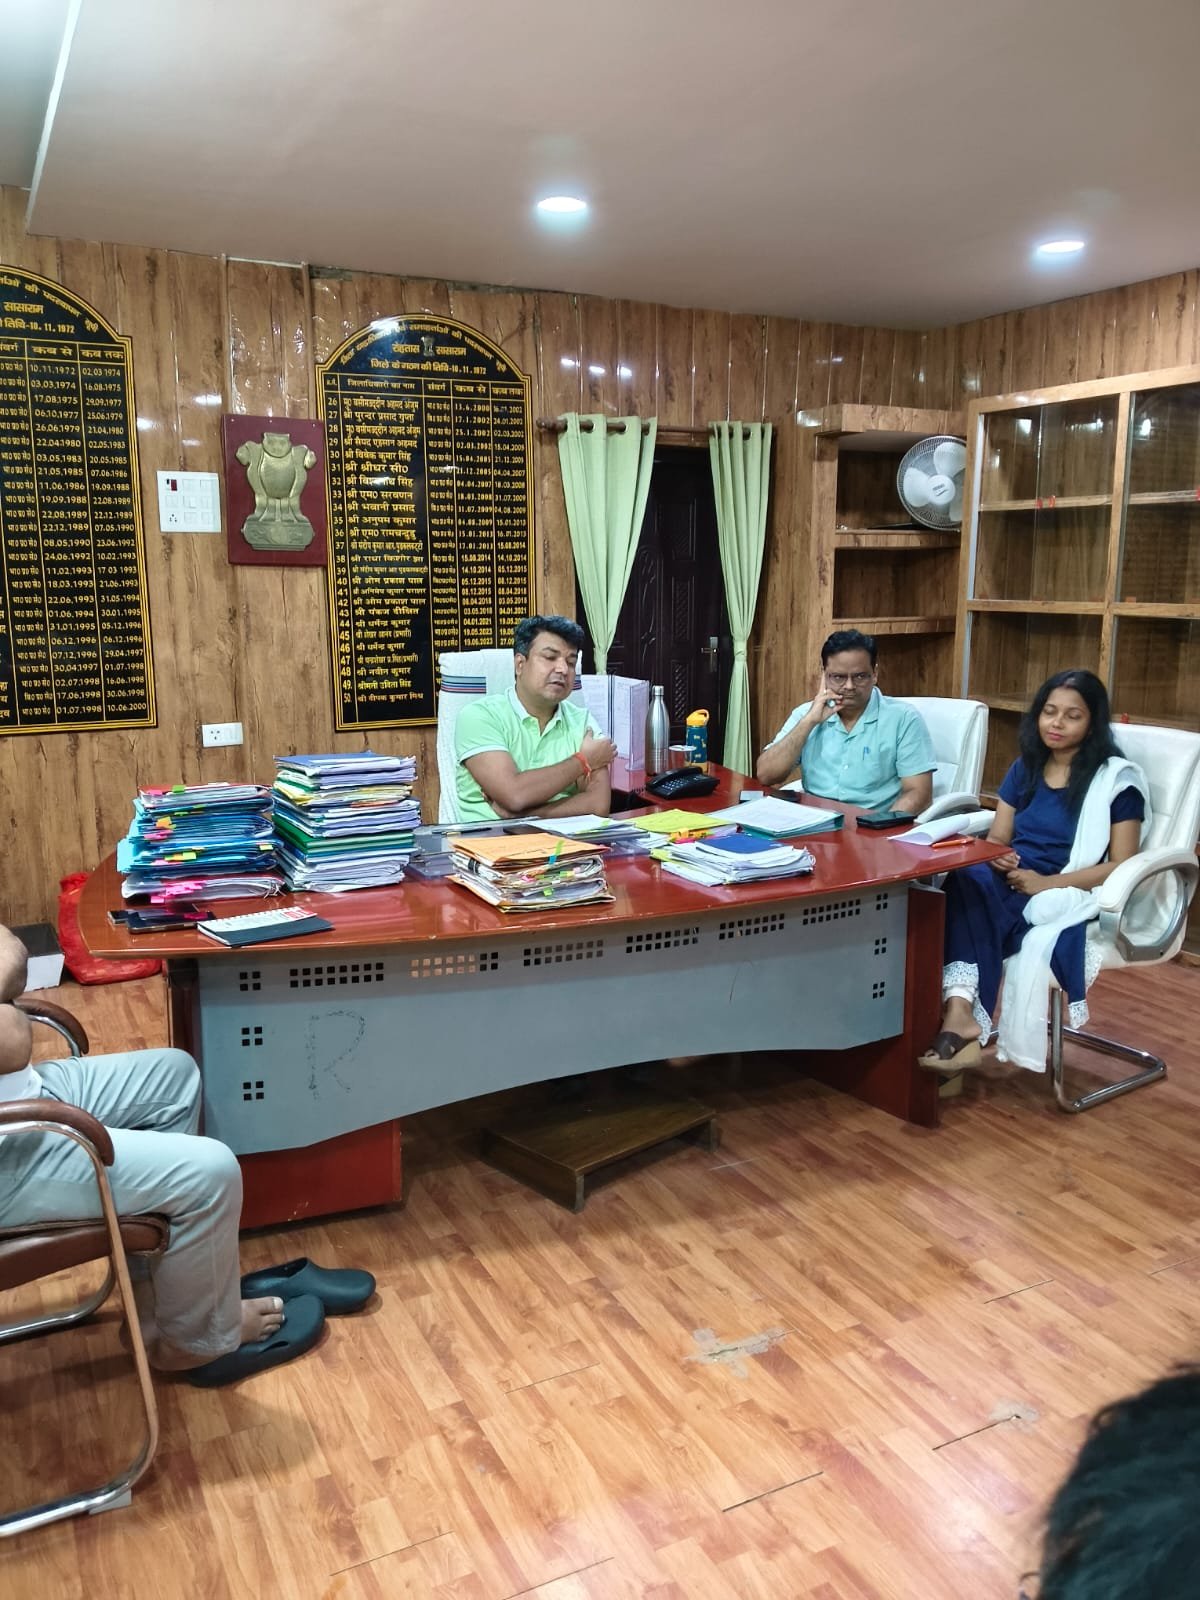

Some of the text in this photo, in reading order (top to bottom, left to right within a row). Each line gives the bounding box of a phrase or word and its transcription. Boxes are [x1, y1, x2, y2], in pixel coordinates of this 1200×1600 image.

[4, 301, 44, 314] सासाराम
[32, 346, 124, 359] कब से कब तक
[435, 346, 467, 356] सासाराम
[30, 364, 76, 375] 10.11.1972
[31, 380, 76, 389] 03.03.1974
[328, 397, 338, 406] 26
[35, 409, 79, 419] 06.10.1977
[328, 411, 338, 419] 27
[378, 412, 397, 420] प्रसाद
[36, 424, 80, 433] 26.06.1979
[329, 424, 338, 433] 28
[329, 438, 338, 446] 29
[37, 455, 82, 463] 03.05.1983
[330, 448, 412, 462] 30 श्री विवेक कुमार सिंह
[331, 461, 387, 472] 31 श्री श्रीधर
[38, 467, 84, 476] 21.05.1985
[332, 477, 341, 486] 32
[346, 474, 357, 485] श्री
[398, 476, 414, 487] सिंह
[40, 482, 85, 490] 11.06.1986
[332, 490, 342, 498] 33
[346, 488, 358, 498] श्री
[42, 496, 87, 504] 19.09.1988
[333, 503, 343, 511] 34
[347, 501, 358, 511] श्री
[391, 504, 416, 513] प्रसाद
[42, 511, 88, 520] 22.08.1989
[333, 516, 344, 524] 35
[348, 514, 360, 524] श्री
[392, 517, 416, 526] कुमार
[43, 524, 89, 532] 22.12.1989
[335, 526, 360, 537] 36 श्री
[43, 539, 91, 548] 08.05.1990
[335, 541, 345, 550] 37
[45, 553, 91, 561] 24.06.1992
[336, 555, 346, 564] 38
[351, 554, 361, 562] श्री
[47, 567, 92, 575] 11.02.1993
[336, 567, 346, 575] 39
[48, 580, 94, 588] 18.03.1993
[337, 577, 347, 585] 40
[352, 576, 361, 585] श्री
[337, 588, 348, 596] 41
[48, 595, 94, 604] 22.06.1993
[338, 599, 348, 607] 42
[353, 597, 363, 605] श्री
[49, 610, 94, 618] 01.06.1994
[339, 609, 349, 617] 43
[354, 607, 365, 616] श्री
[50, 622, 96, 631] 31.01.1995
[355, 619, 366, 627] श्री
[391, 619, 411, 628] कुमार
[340, 630, 350, 640] 45
[51, 637, 97, 645] 06.12.1996
[340, 643, 350, 653] 46
[356, 643, 365, 651] श्री
[387, 643, 405, 652] कुमार
[52, 652, 98, 660] 07.12.1996
[341, 655, 351, 665] 47
[341, 667, 351, 676] 48
[356, 667, 366, 676] श्री
[391, 667, 411, 677] कुमार
[55, 678, 100, 687] 02.07.1998
[57, 692, 101, 700] 17.06.1998
[358, 693, 367, 702] श्री
[56, 706, 102, 715] 01.07.1998
[306, 1009, 366, 1099] R
